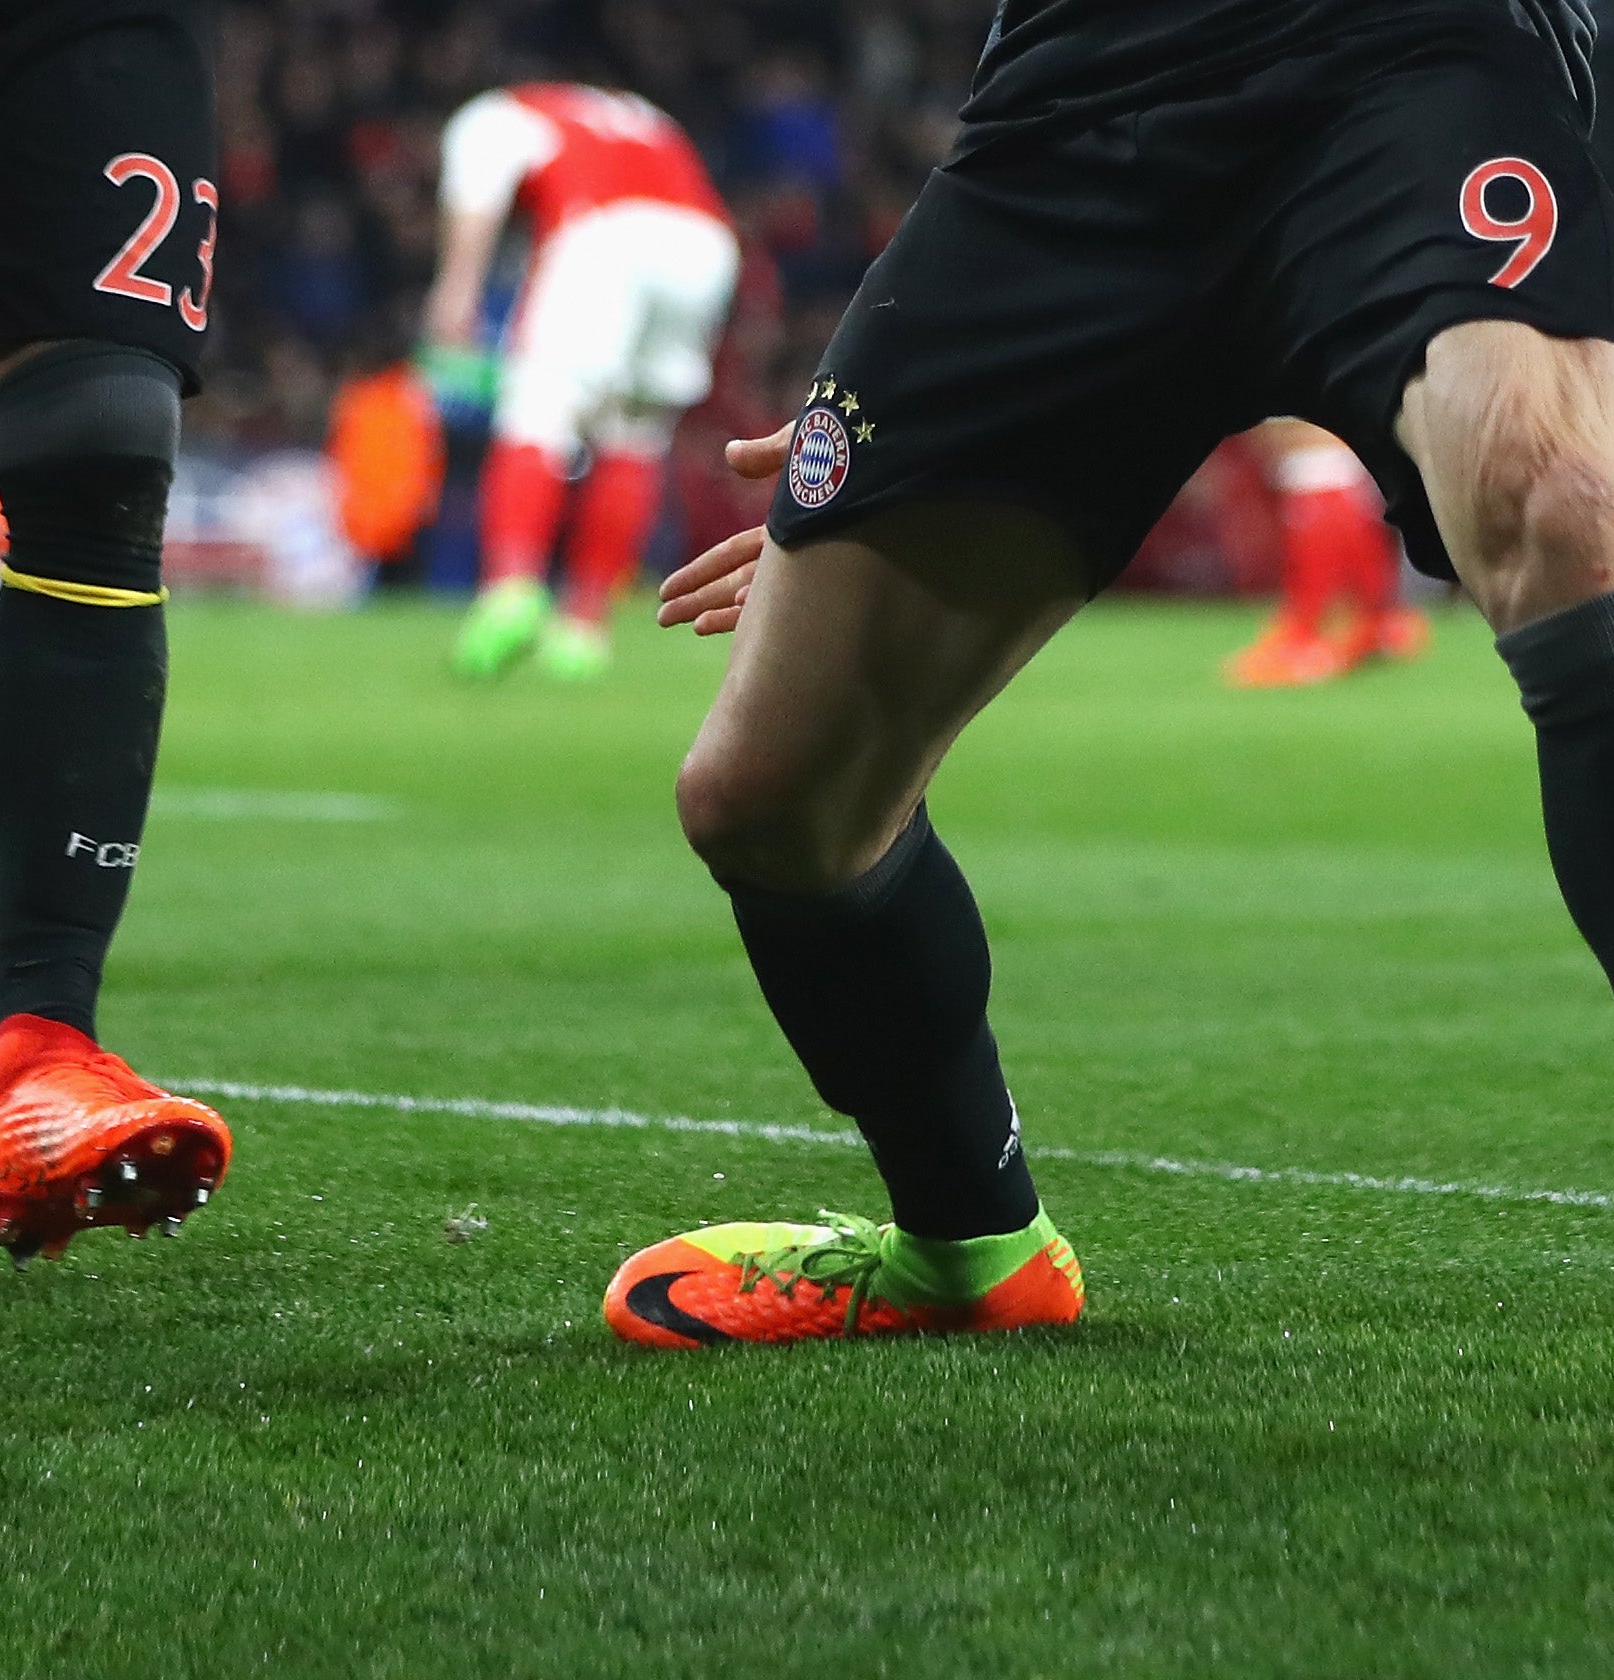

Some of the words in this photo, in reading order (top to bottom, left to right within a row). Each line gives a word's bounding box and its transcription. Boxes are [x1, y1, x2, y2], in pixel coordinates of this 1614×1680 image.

[93, 152, 219, 332] 23
[1458, 156, 1560, 290] 9
[814, 414, 847, 468] BAYERN
[66, 831, 141, 868] FCB
